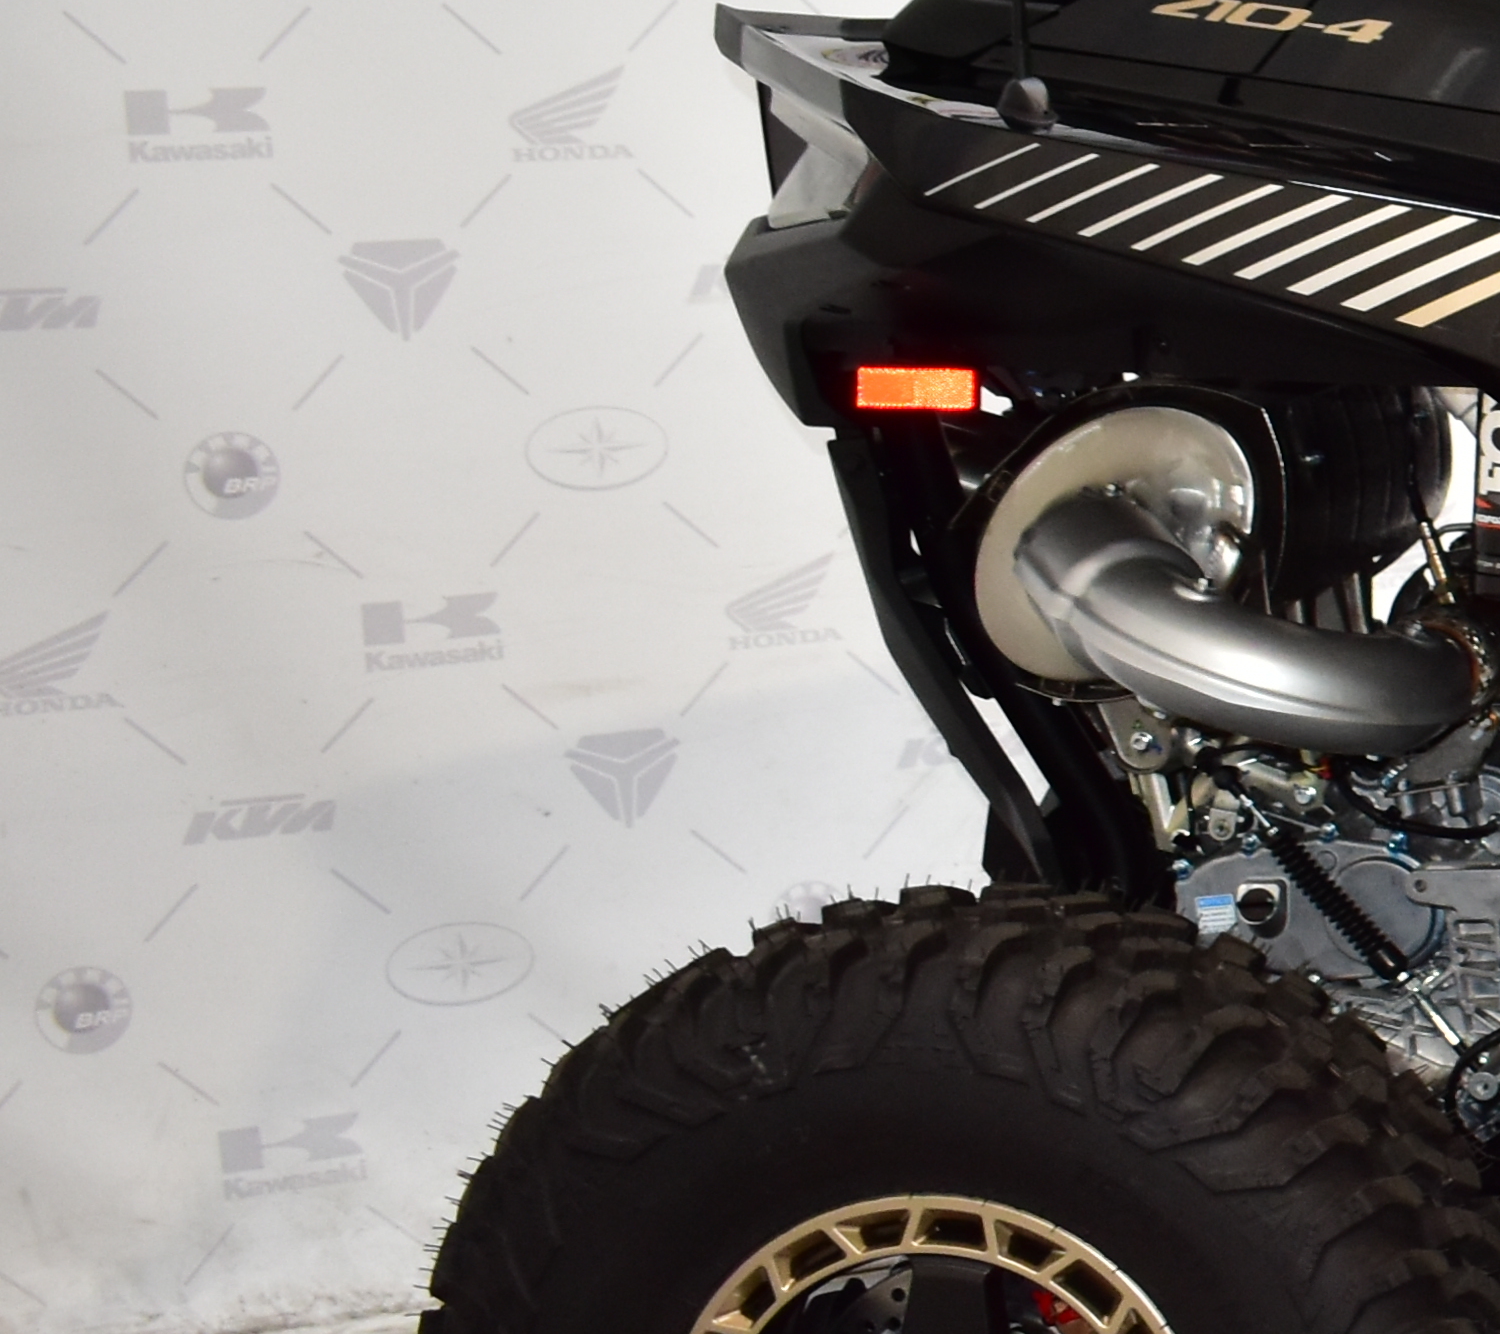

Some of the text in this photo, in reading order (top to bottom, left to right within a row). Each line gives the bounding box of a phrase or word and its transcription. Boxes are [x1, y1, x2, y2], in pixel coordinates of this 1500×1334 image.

[128, 135, 273, 163] Kawasaki
[511, 143, 635, 163] HONDA
[0, 286, 102, 331] TM
[728, 626, 845, 651] HONDA
[364, 639, 505, 673] Kawasaki
[182, 793, 336, 847] KTM
[223, 1157, 367, 1201] Kawasaki
